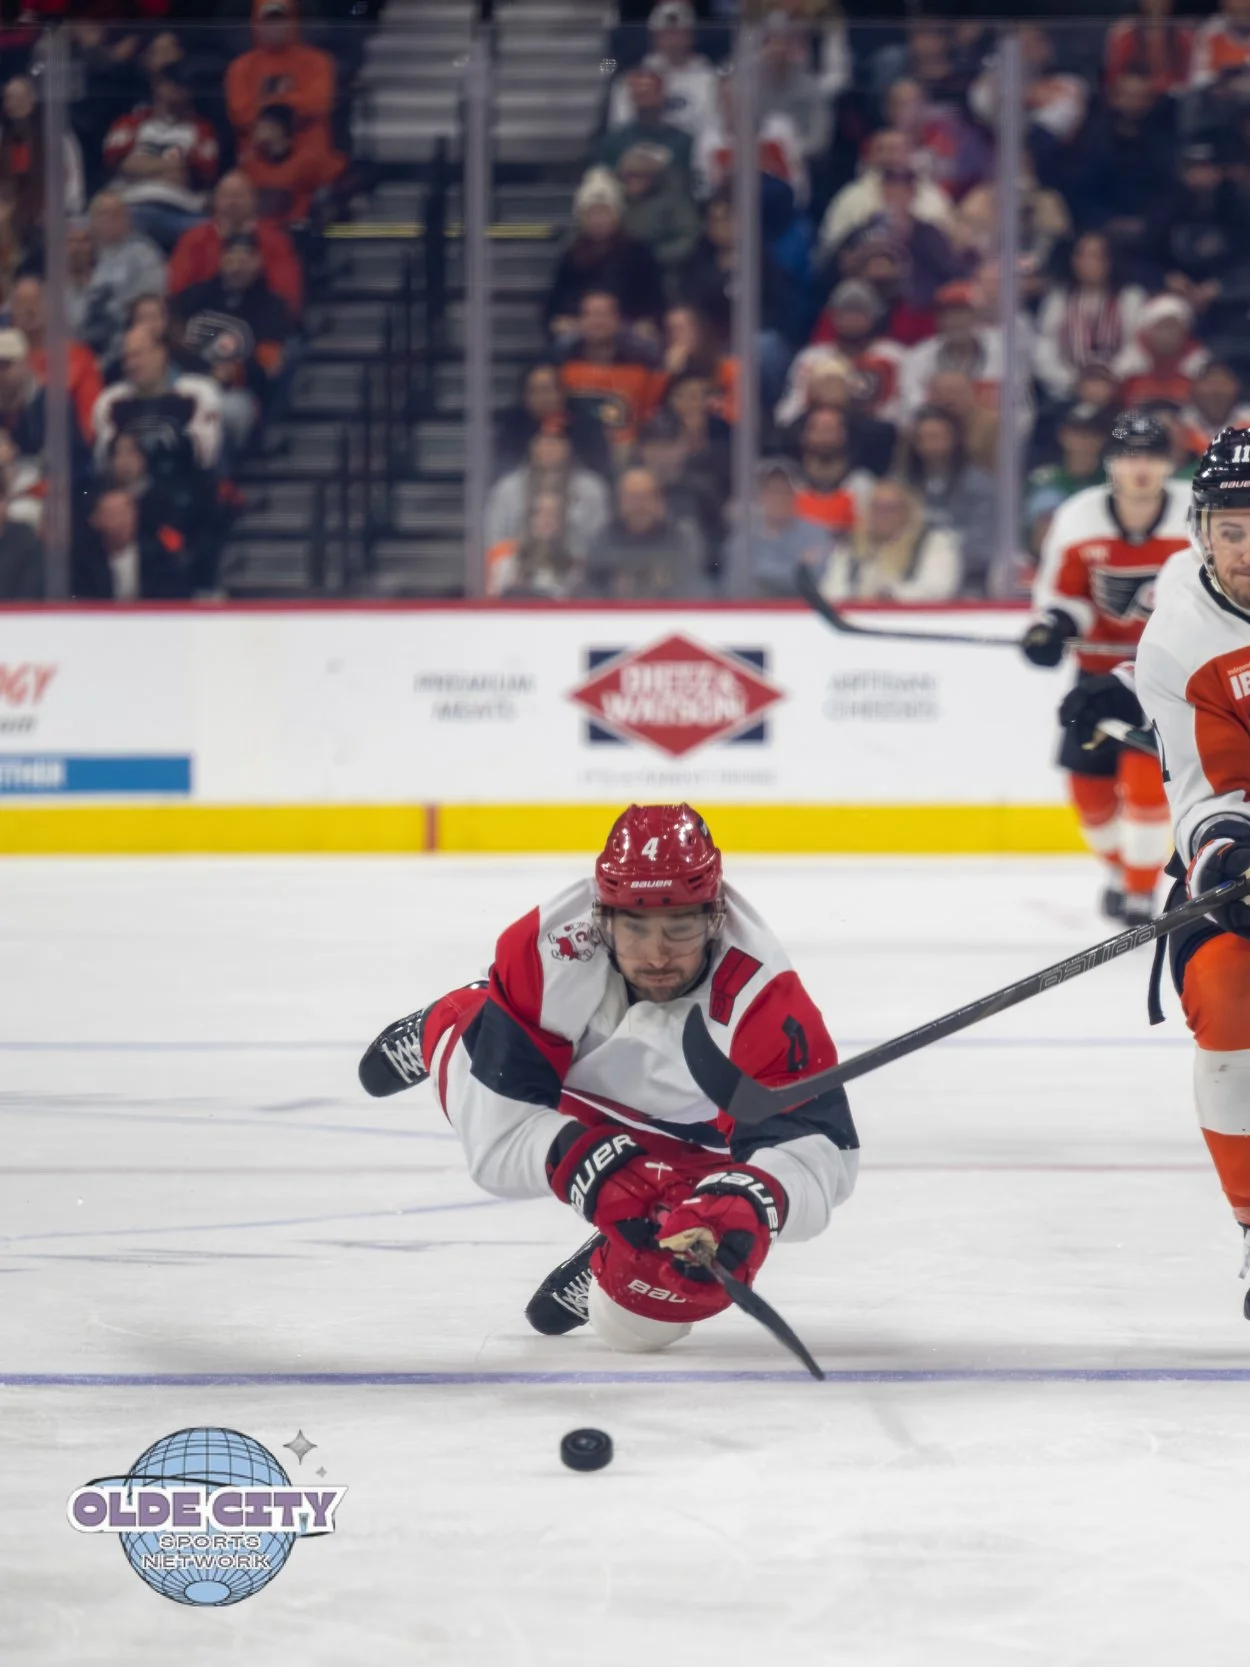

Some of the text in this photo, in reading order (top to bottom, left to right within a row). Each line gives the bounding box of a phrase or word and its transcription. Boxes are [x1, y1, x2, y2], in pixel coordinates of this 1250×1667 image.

[1231, 445, 1250, 463] 11
[0, 663, 58, 706] GY
[641, 836, 660, 862] 4
[630, 879, 673, 889] BAUER
[627, 1279, 687, 1303] BAU
